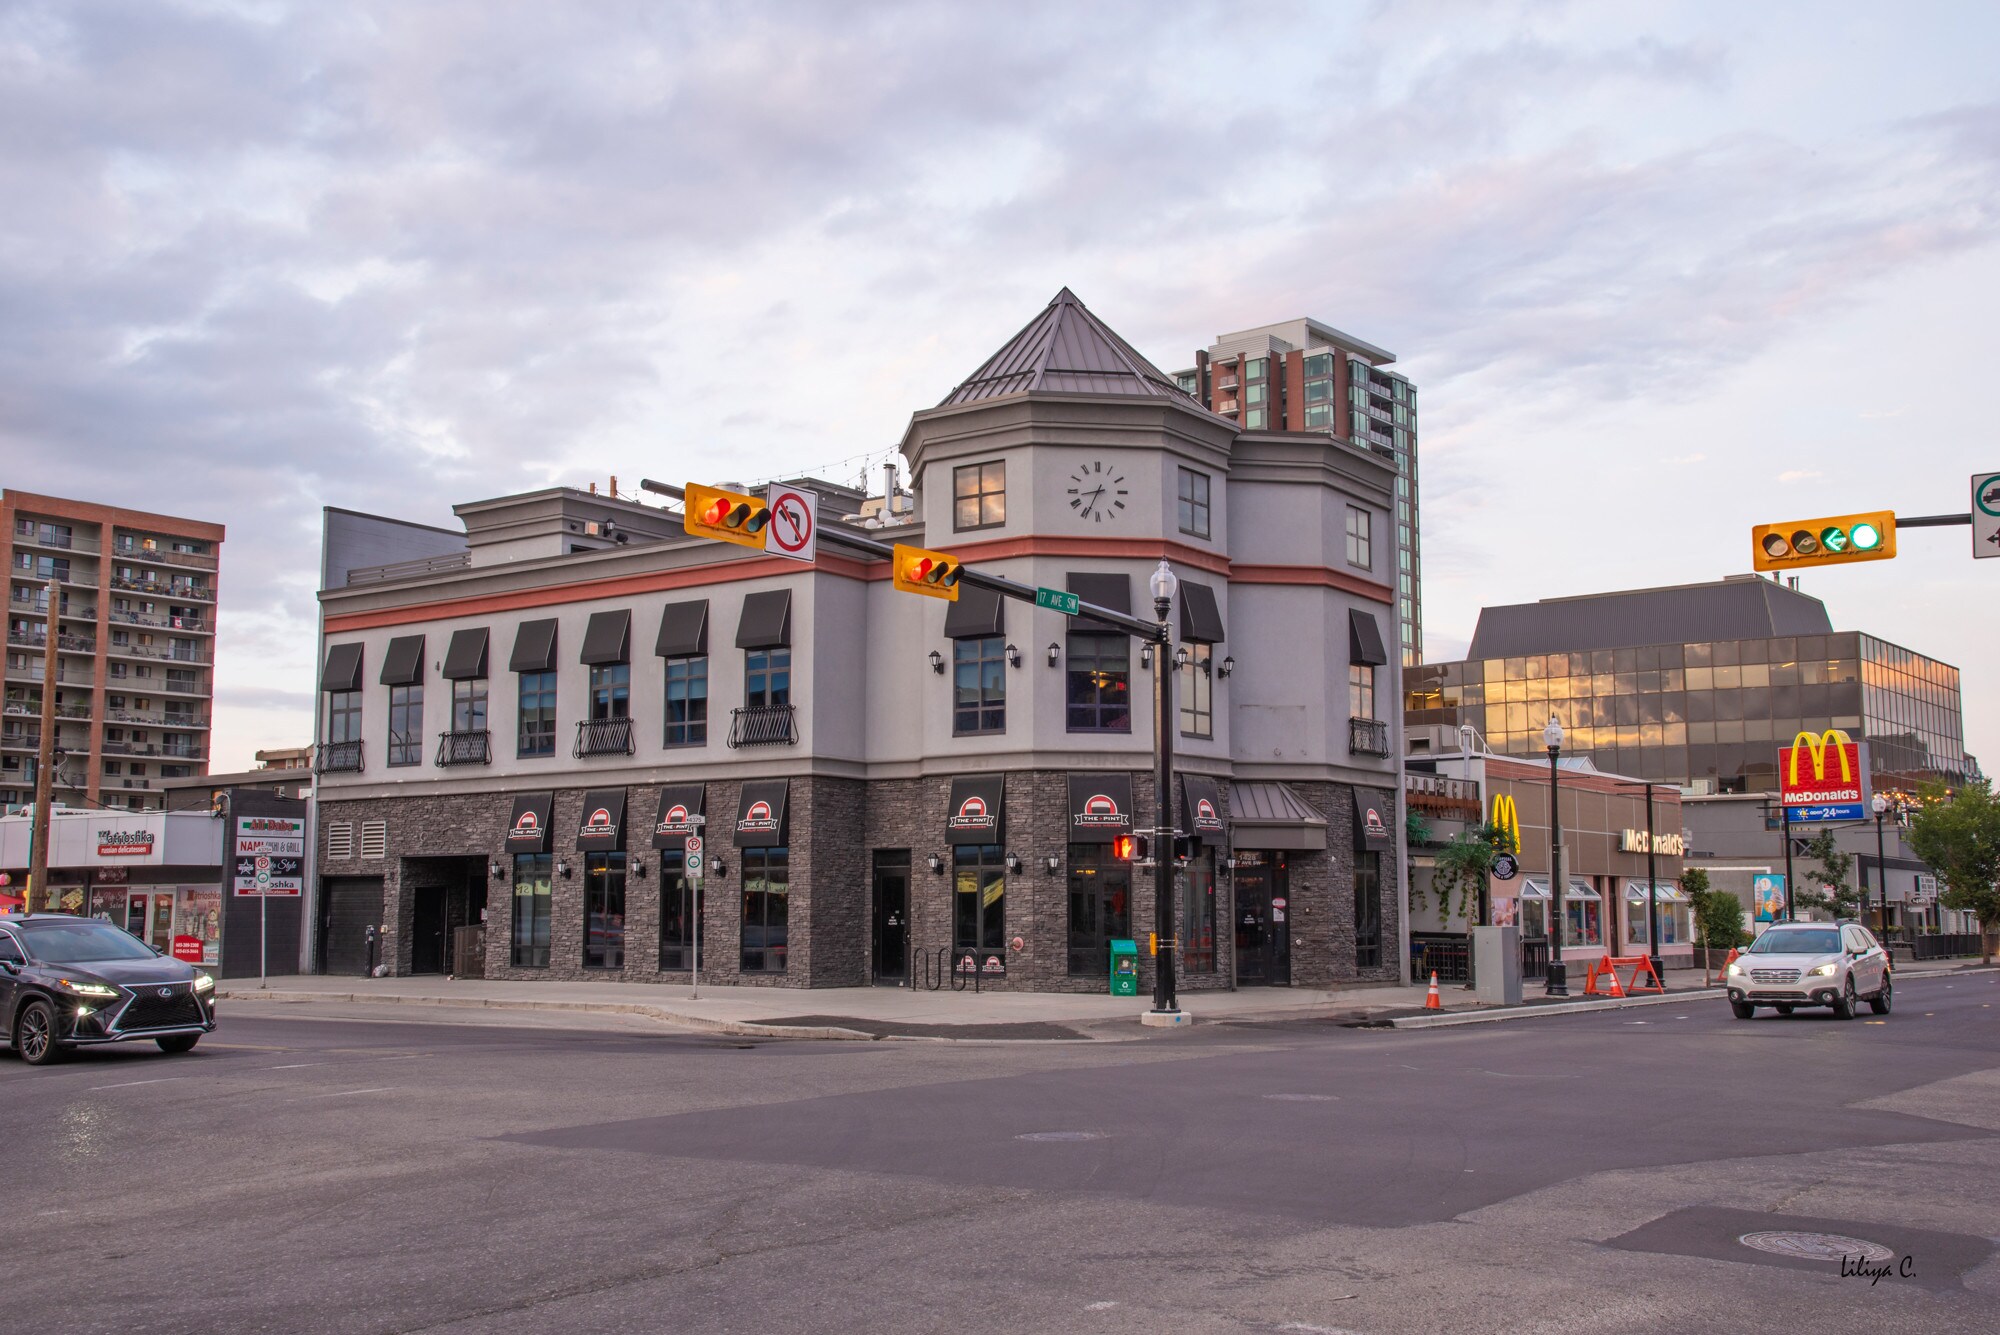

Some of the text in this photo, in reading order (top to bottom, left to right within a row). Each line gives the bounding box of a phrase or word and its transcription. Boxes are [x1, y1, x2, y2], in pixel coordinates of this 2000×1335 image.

[1040, 592, 1077, 610] 17 AVE SW
[1784, 789, 1859, 803] McDonald's
[1822, 807, 1837, 818] 24
[267, 819, 295, 831] Baba
[281, 841, 286, 853] &
[286, 842, 301, 853] GRILL
[1624, 828, 1684, 857] McDnald's
[101, 845, 147, 854] russian delicatessen
[277, 858, 298, 872] Style
